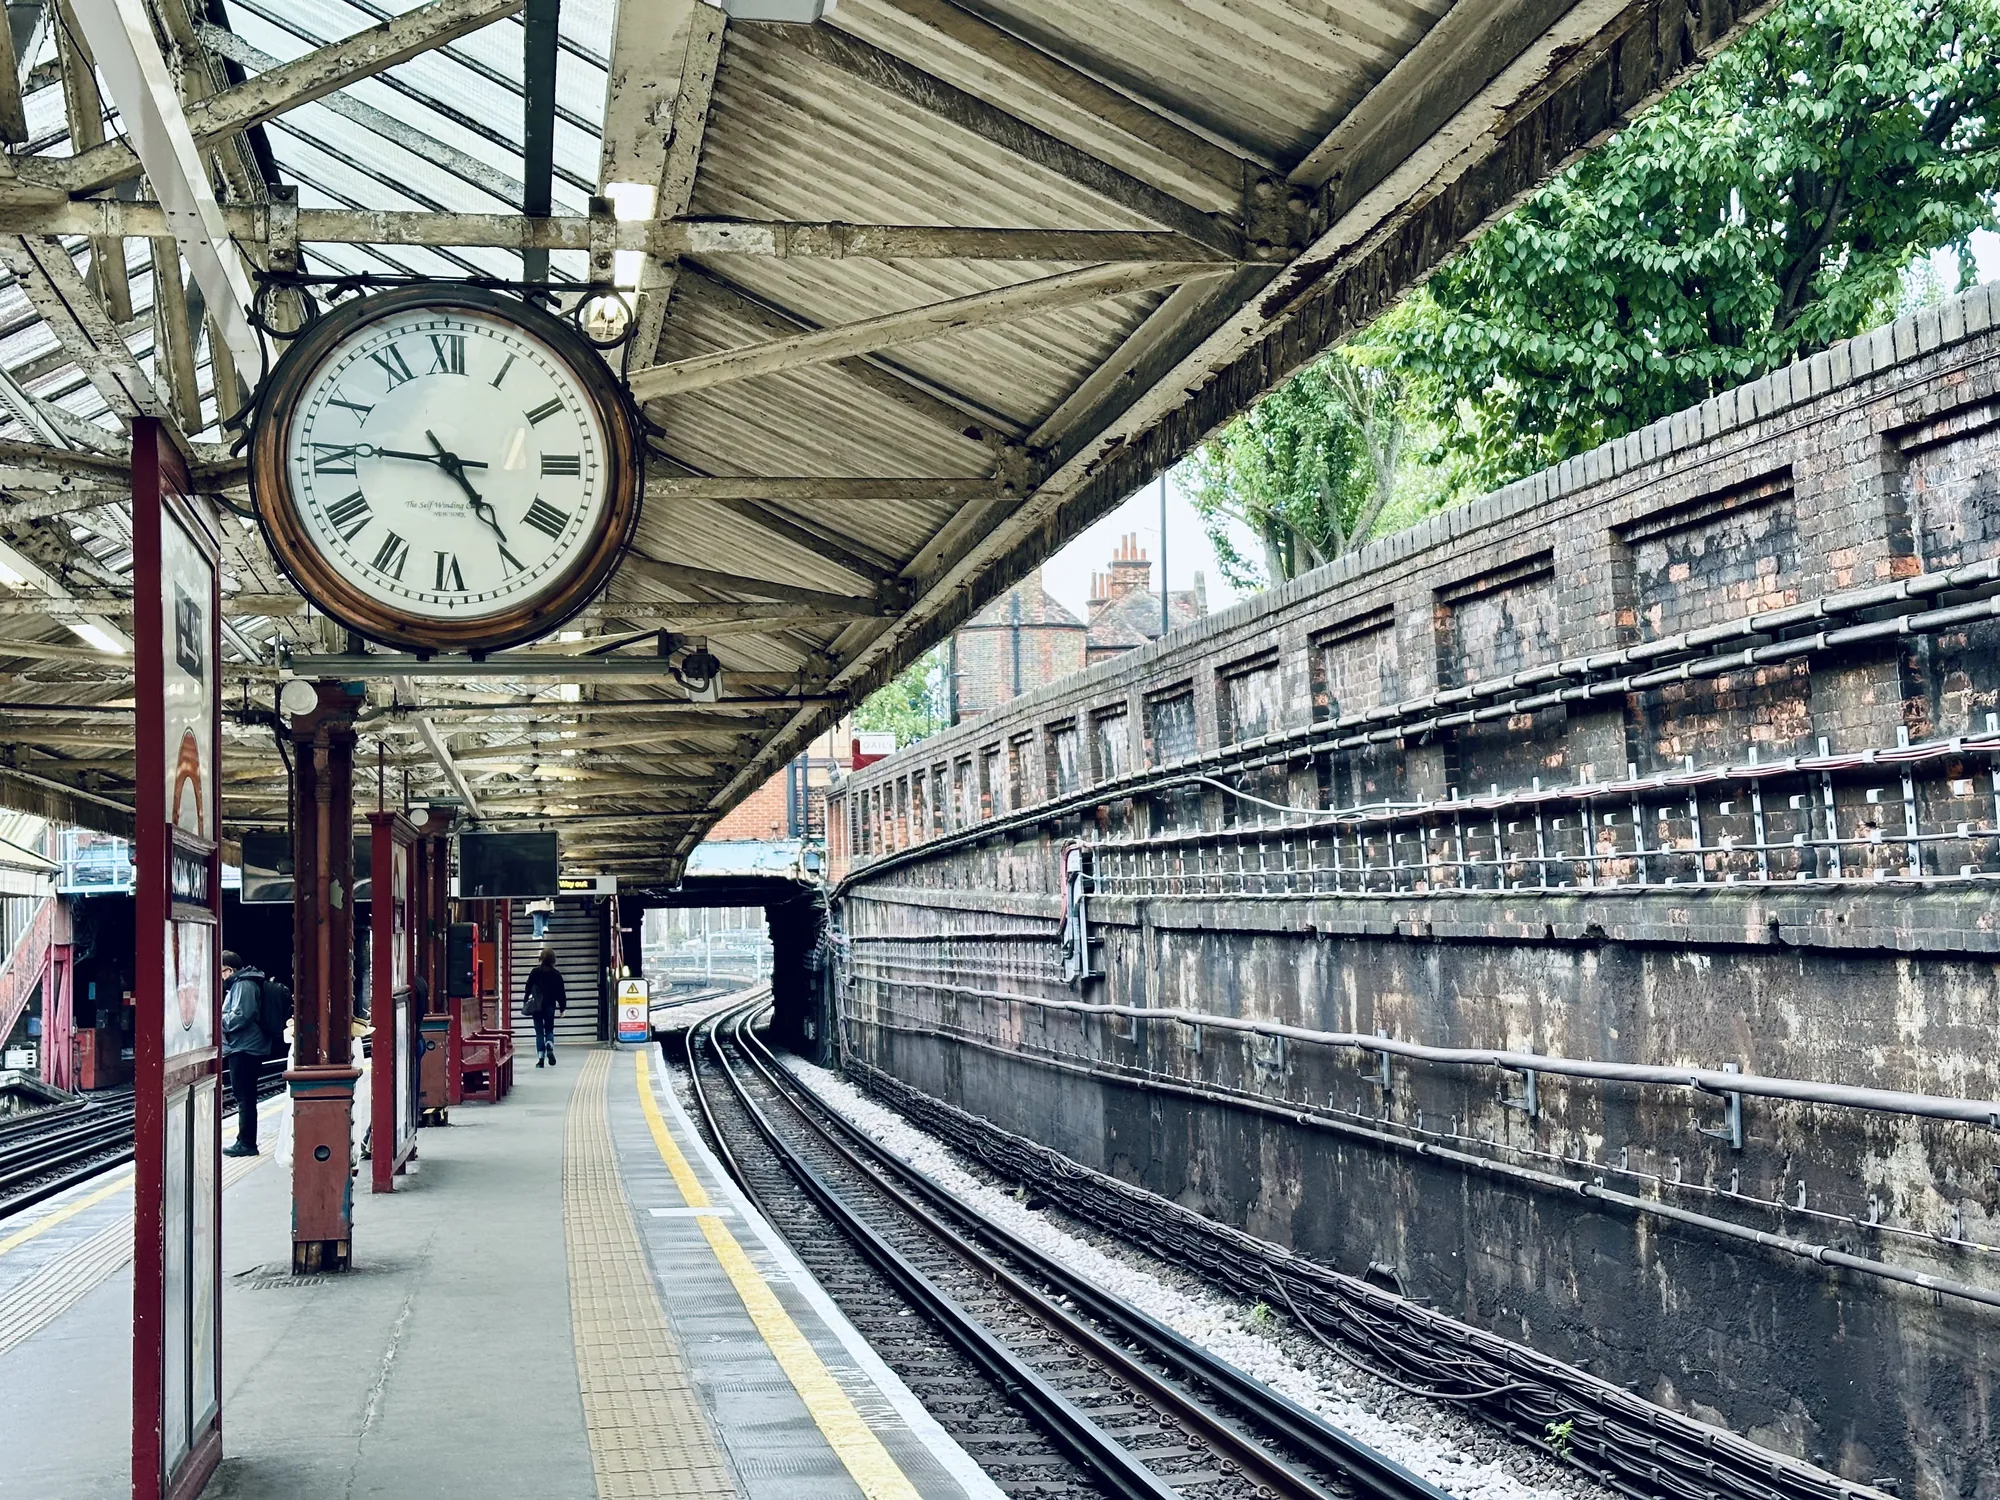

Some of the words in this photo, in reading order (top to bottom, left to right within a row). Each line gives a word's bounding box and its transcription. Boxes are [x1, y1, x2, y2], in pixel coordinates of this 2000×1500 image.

[364, 341, 419, 393] XI
[425, 333, 470, 376] XII
[487, 350, 520, 391] I
[325, 383, 376, 428] X
[521, 393, 567, 429] II
[313, 442, 358, 479] IX
[540, 450, 581, 479] III
[323, 486, 375, 546] VIII
[404, 500, 418, 509] The
[434, 501, 464, 511] Winding
[519, 493, 572, 543] IIII
[368, 528, 411, 583] VII
[431, 550, 469, 592] VI
[496, 540, 530, 582] V
[559, 880, 575, 889] Way
[575, 880, 588, 888] out
